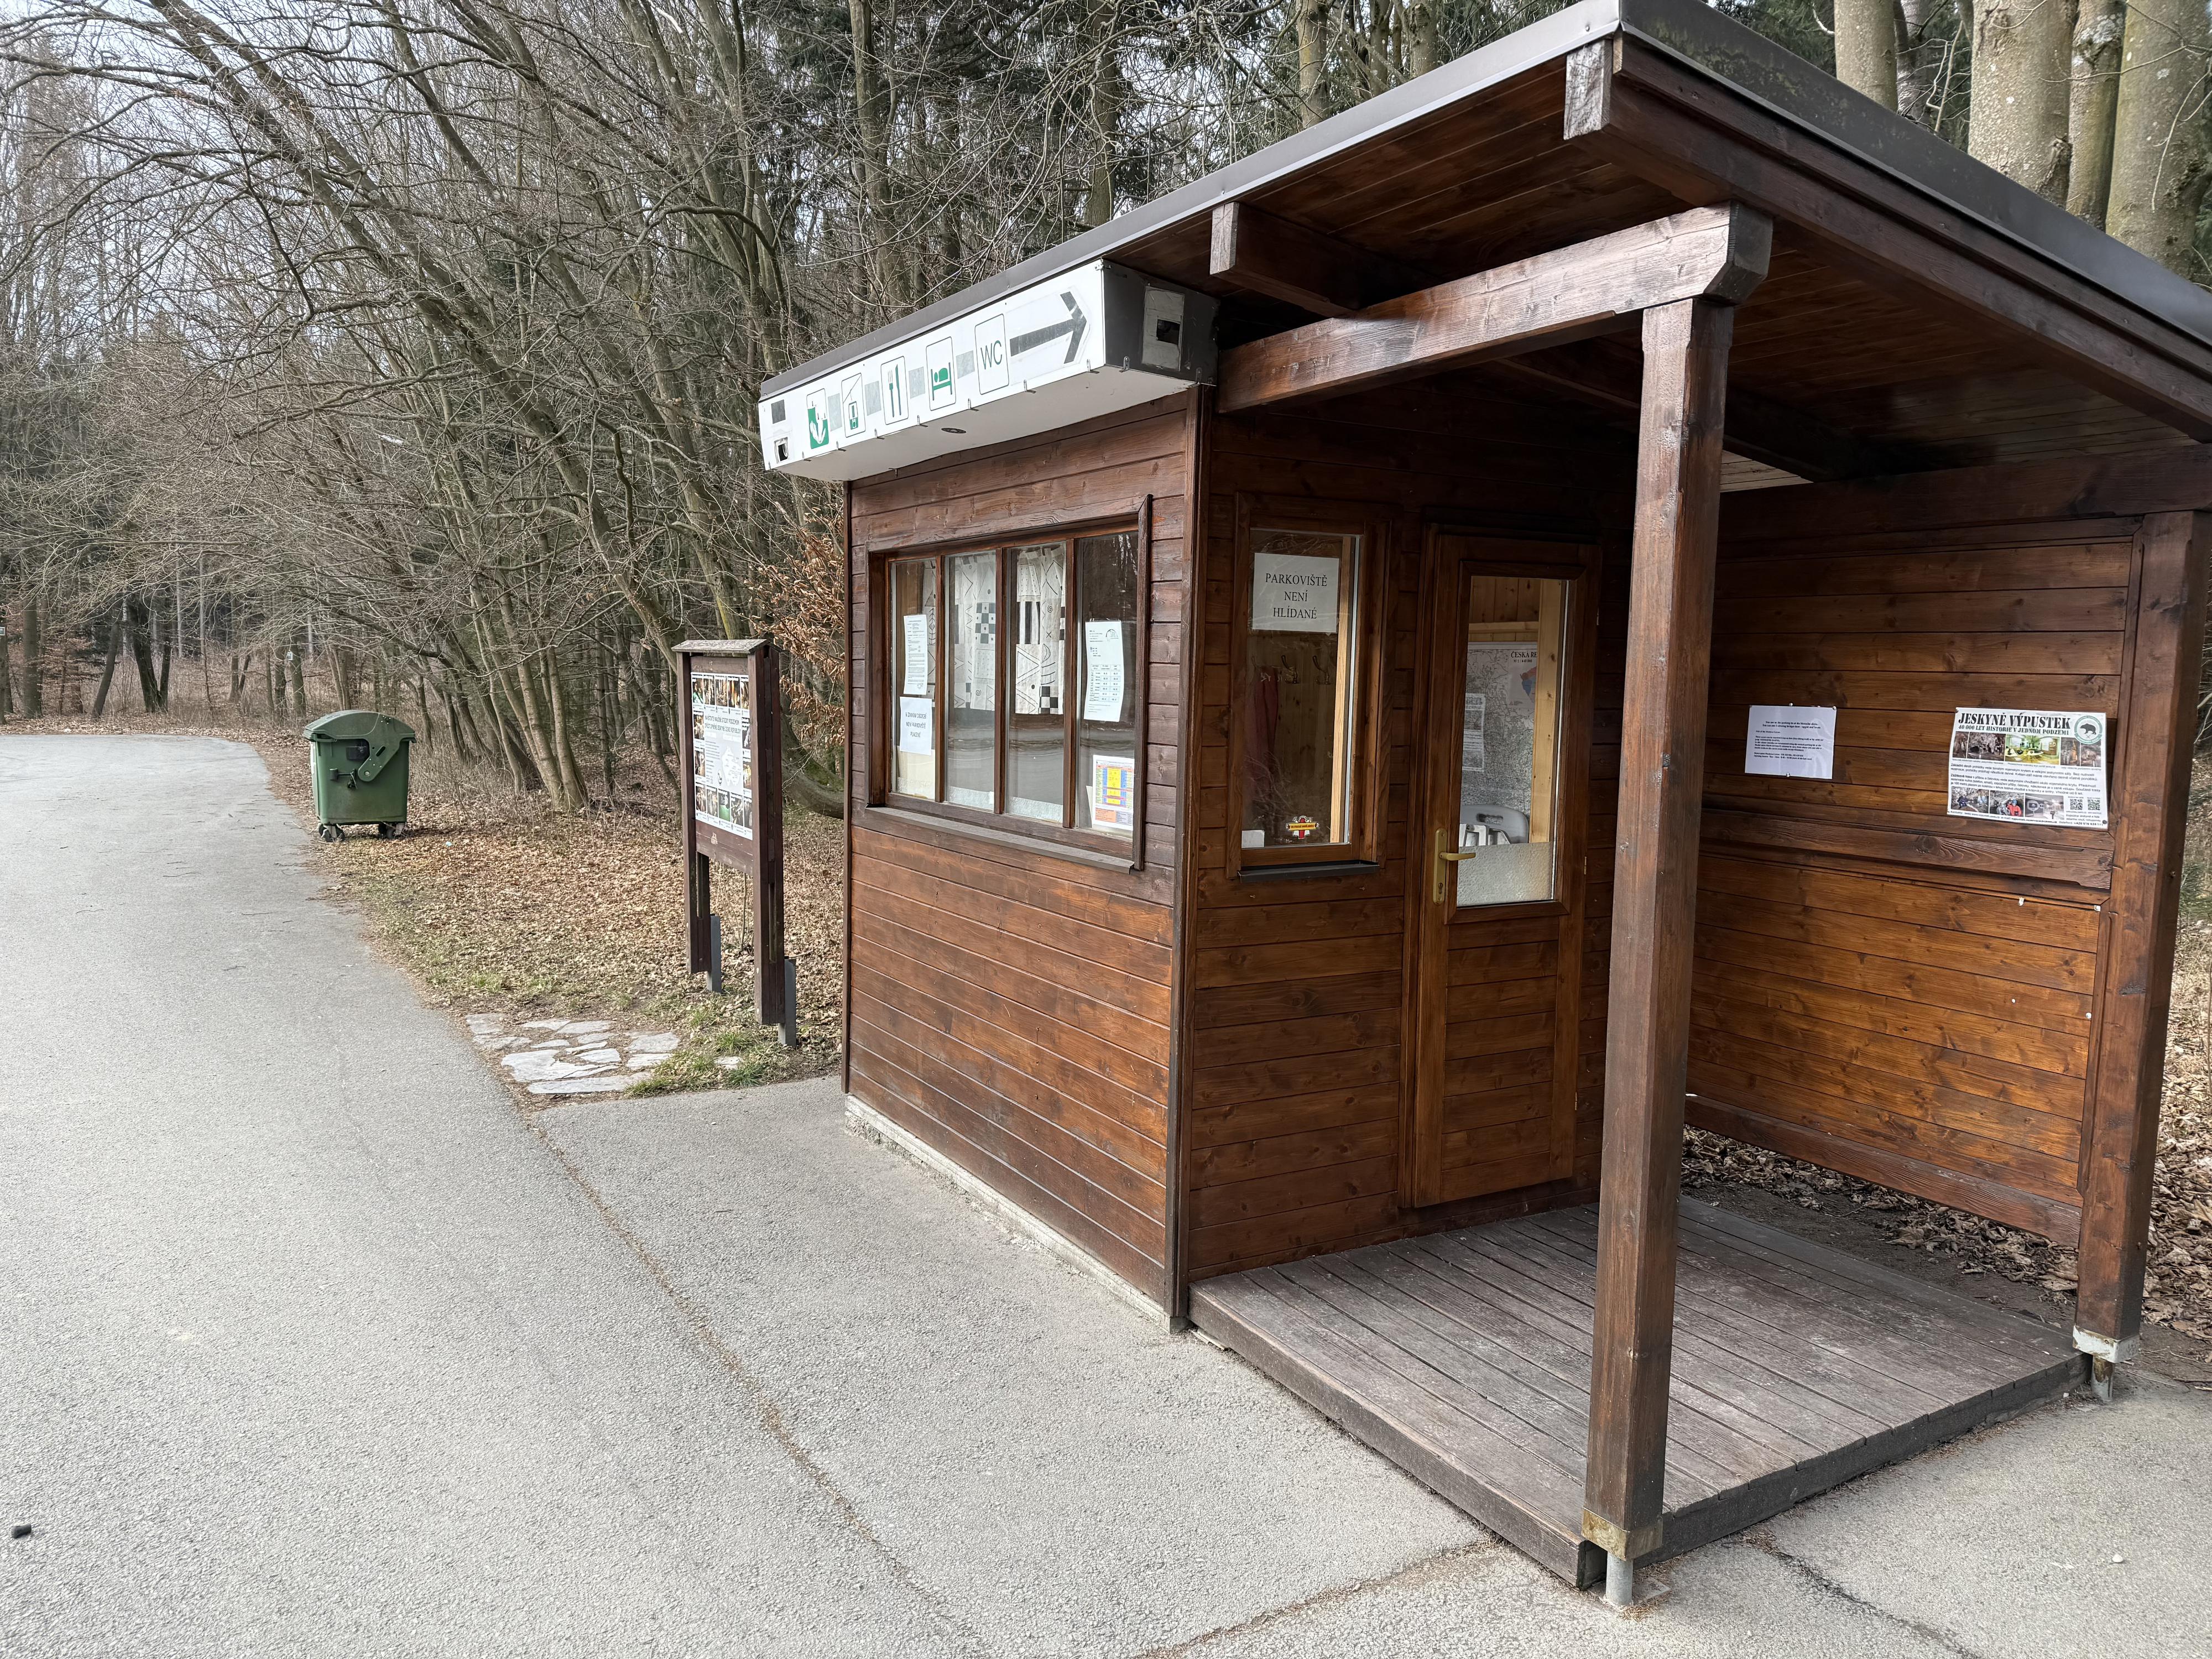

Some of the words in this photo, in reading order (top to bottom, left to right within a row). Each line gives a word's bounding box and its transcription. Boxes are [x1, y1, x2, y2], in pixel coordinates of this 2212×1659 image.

[980, 340, 1002, 369] WC
[1265, 573, 1327, 586] PARKOVIŠTĚ
[1284, 589, 1308, 601] NENÍ
[1273, 606, 1317, 618] HLÍDANÉ
[1958, 712, 2006, 726] JESKYNĚ
[2010, 713, 2071, 729] VÝPUSTEK
